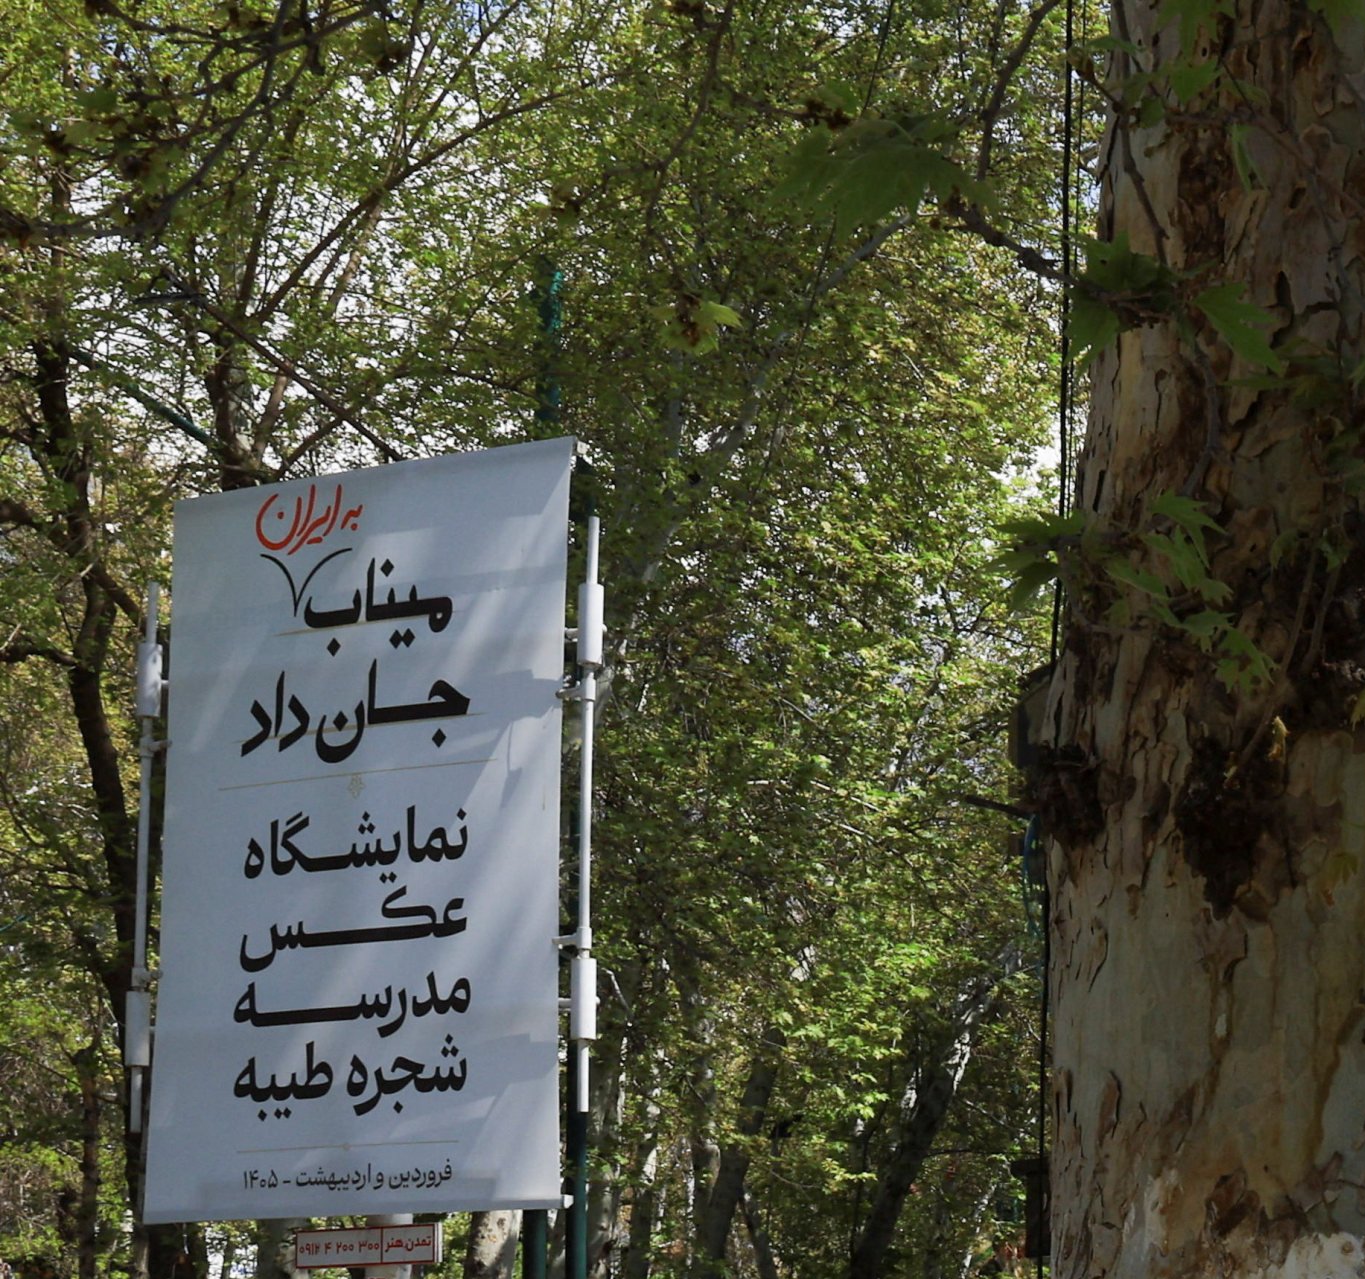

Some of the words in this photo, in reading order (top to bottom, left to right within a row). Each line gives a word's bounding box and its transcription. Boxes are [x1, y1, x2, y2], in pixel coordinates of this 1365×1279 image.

[255, 483, 342, 556] ایران
[340, 504, 364, 531] به
[303, 557, 453, 657] میناب
[241, 670, 310, 757] داد
[315, 658, 471, 763] جان
[243, 804, 468, 884] نمایشگاه
[239, 885, 468, 973] عکس
[233, 971, 471, 1039] مدرسه
[233, 1041, 334, 1122] طیبه
[346, 1033, 467, 1117] شجره
[243, 1169, 279, 1190] ۱۴۰۵
[295, 1163, 372, 1191] اردیبهشت
[373, 1174, 384, 1190] و
[388, 1158, 453, 1190] فروردین
